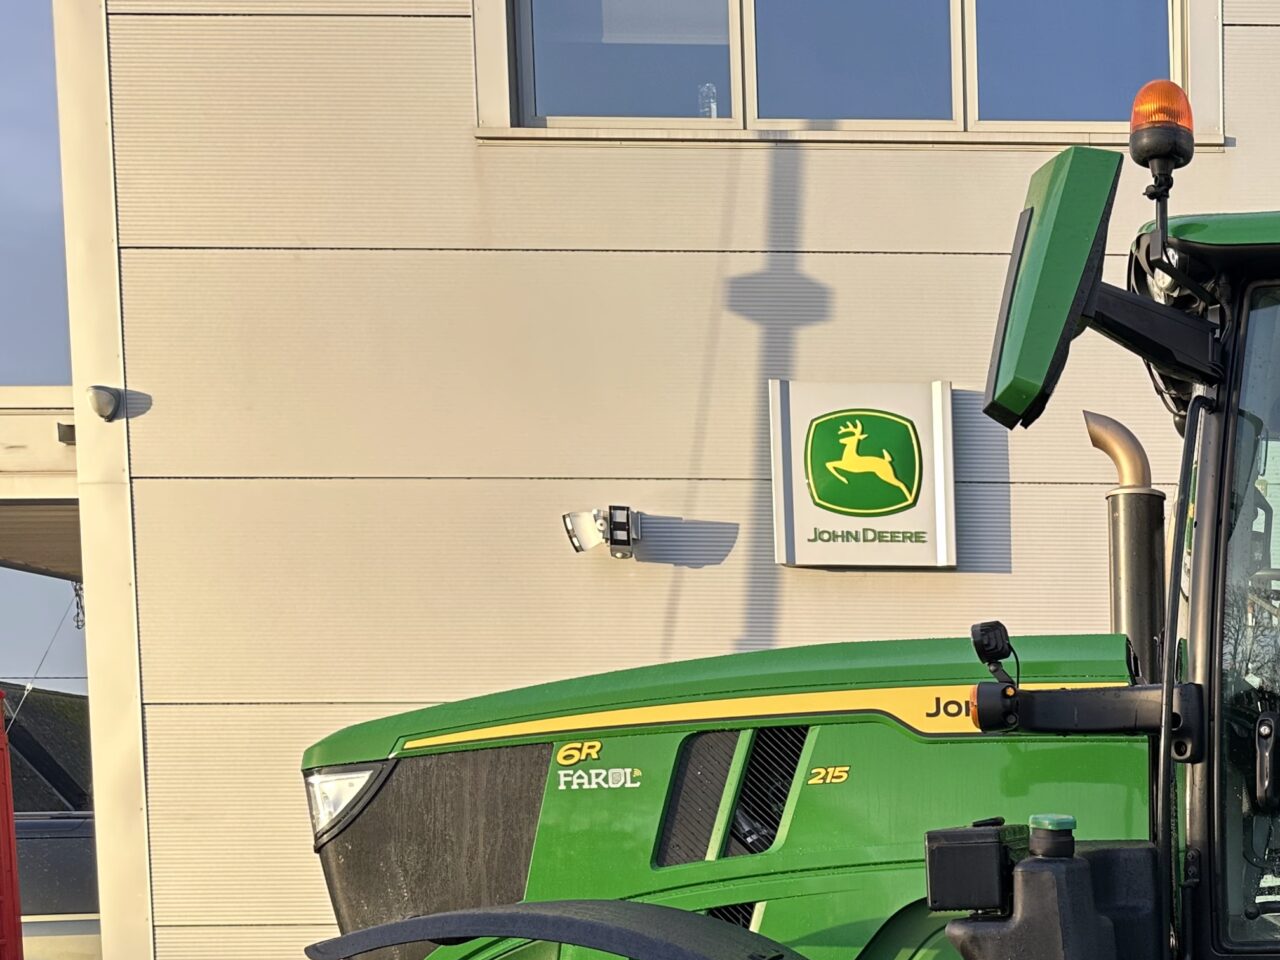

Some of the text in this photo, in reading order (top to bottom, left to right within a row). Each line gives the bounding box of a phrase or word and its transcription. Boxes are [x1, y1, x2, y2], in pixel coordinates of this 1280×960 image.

[807, 527, 928, 545] JOHN DEERE
[556, 740, 602, 766] 6R
[557, 767, 641, 790] FAROL
[807, 766, 850, 785] 215
